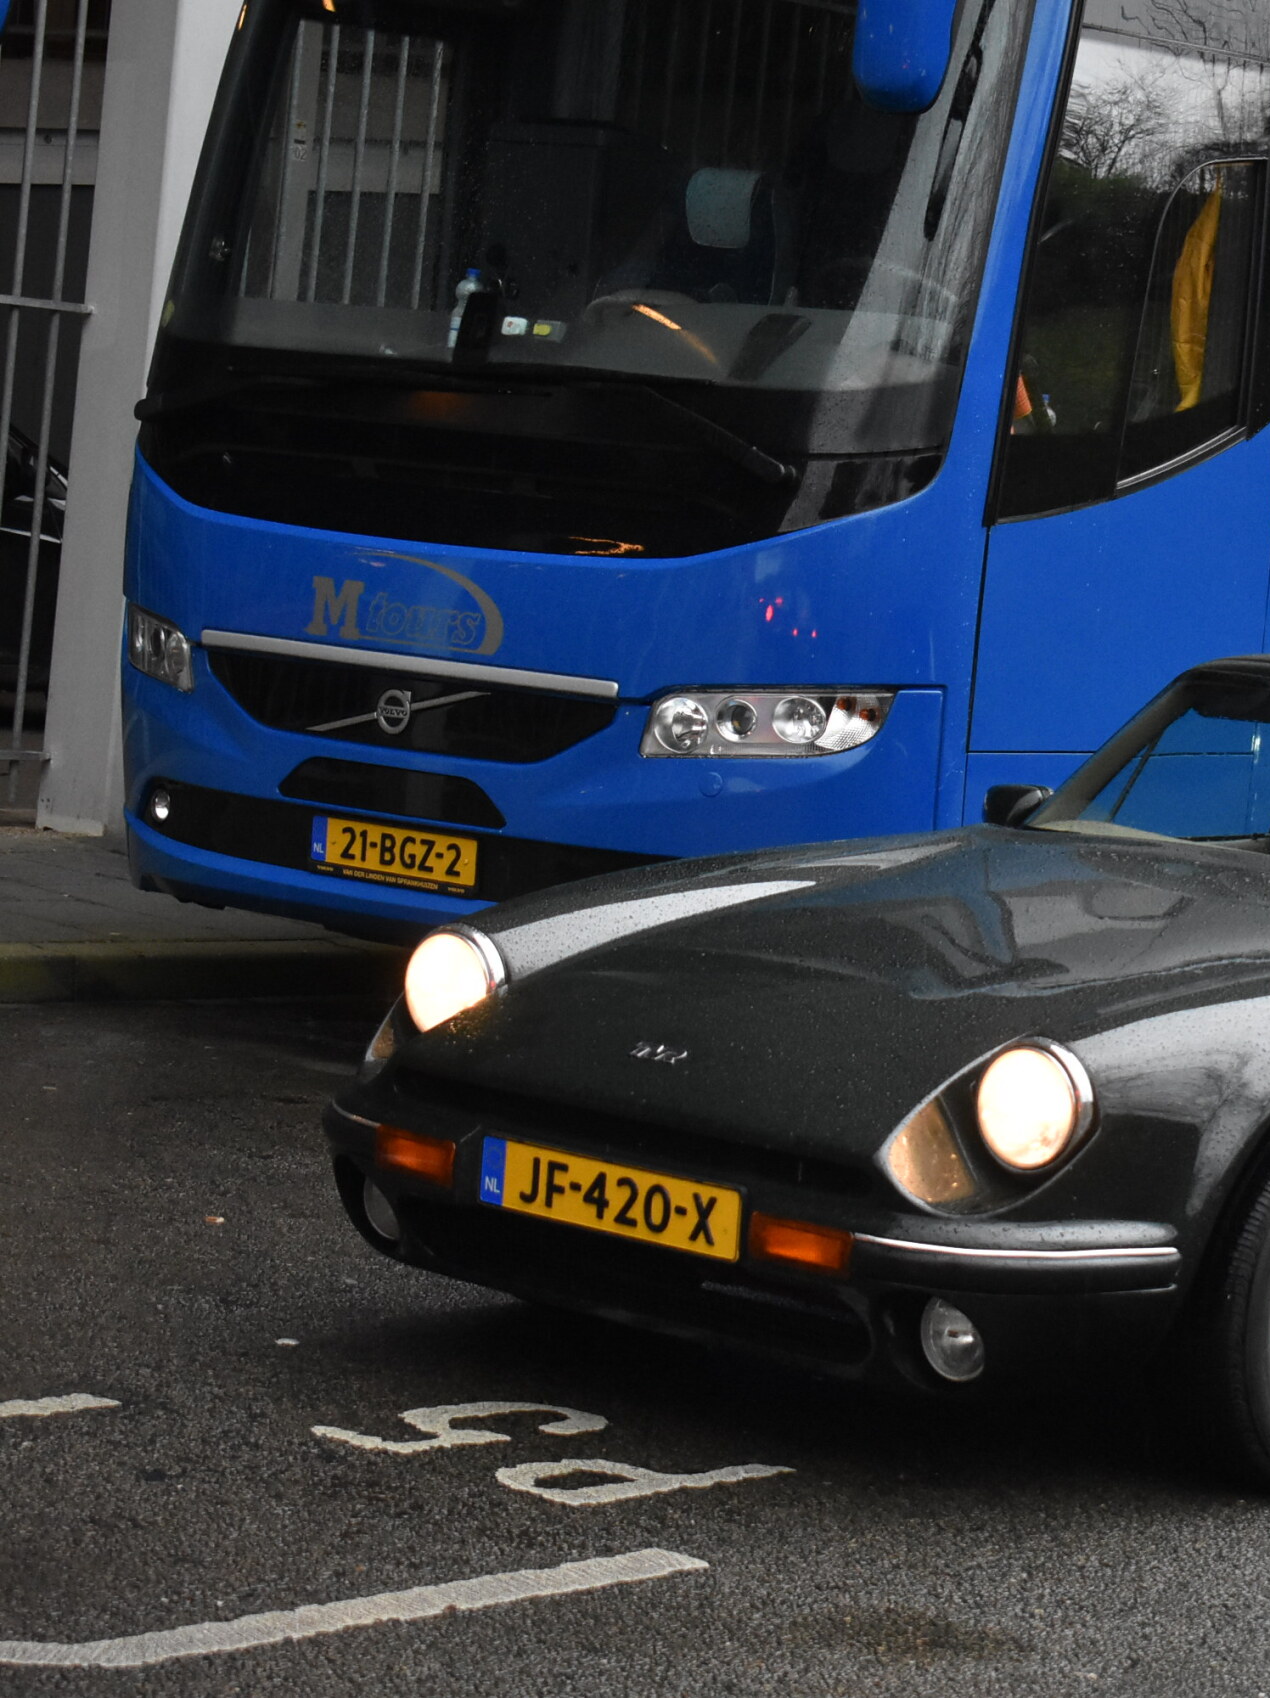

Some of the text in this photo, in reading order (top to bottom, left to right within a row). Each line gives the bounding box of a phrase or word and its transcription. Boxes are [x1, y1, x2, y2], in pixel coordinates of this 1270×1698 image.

[305, 575, 482, 646] M tours
[312, 842, 325, 855] NL
[340, 826, 462, 877] 21-BGZ-2
[484, 1175, 501, 1194] NL
[518, 1156, 718, 1247] JF-420-X
